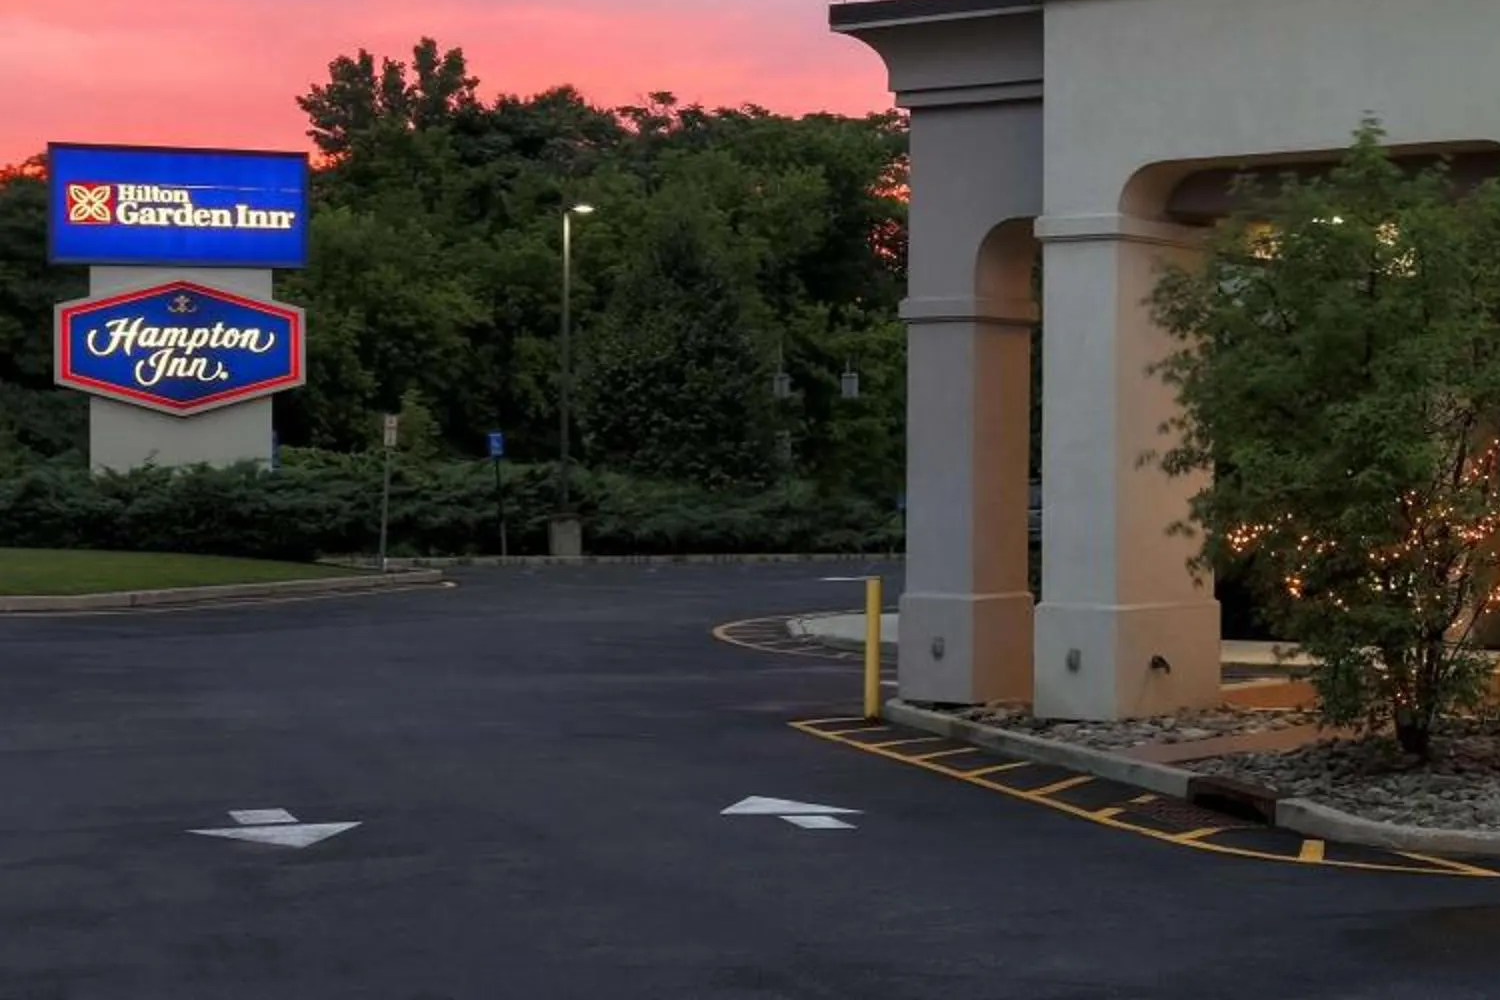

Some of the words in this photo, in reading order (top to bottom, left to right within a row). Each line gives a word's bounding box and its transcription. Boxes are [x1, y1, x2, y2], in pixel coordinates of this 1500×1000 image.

[117, 183, 191, 204] Hilton
[116, 203, 235, 228] Garden
[236, 204, 295, 229] Inn
[87, 317, 275, 356] Hampton
